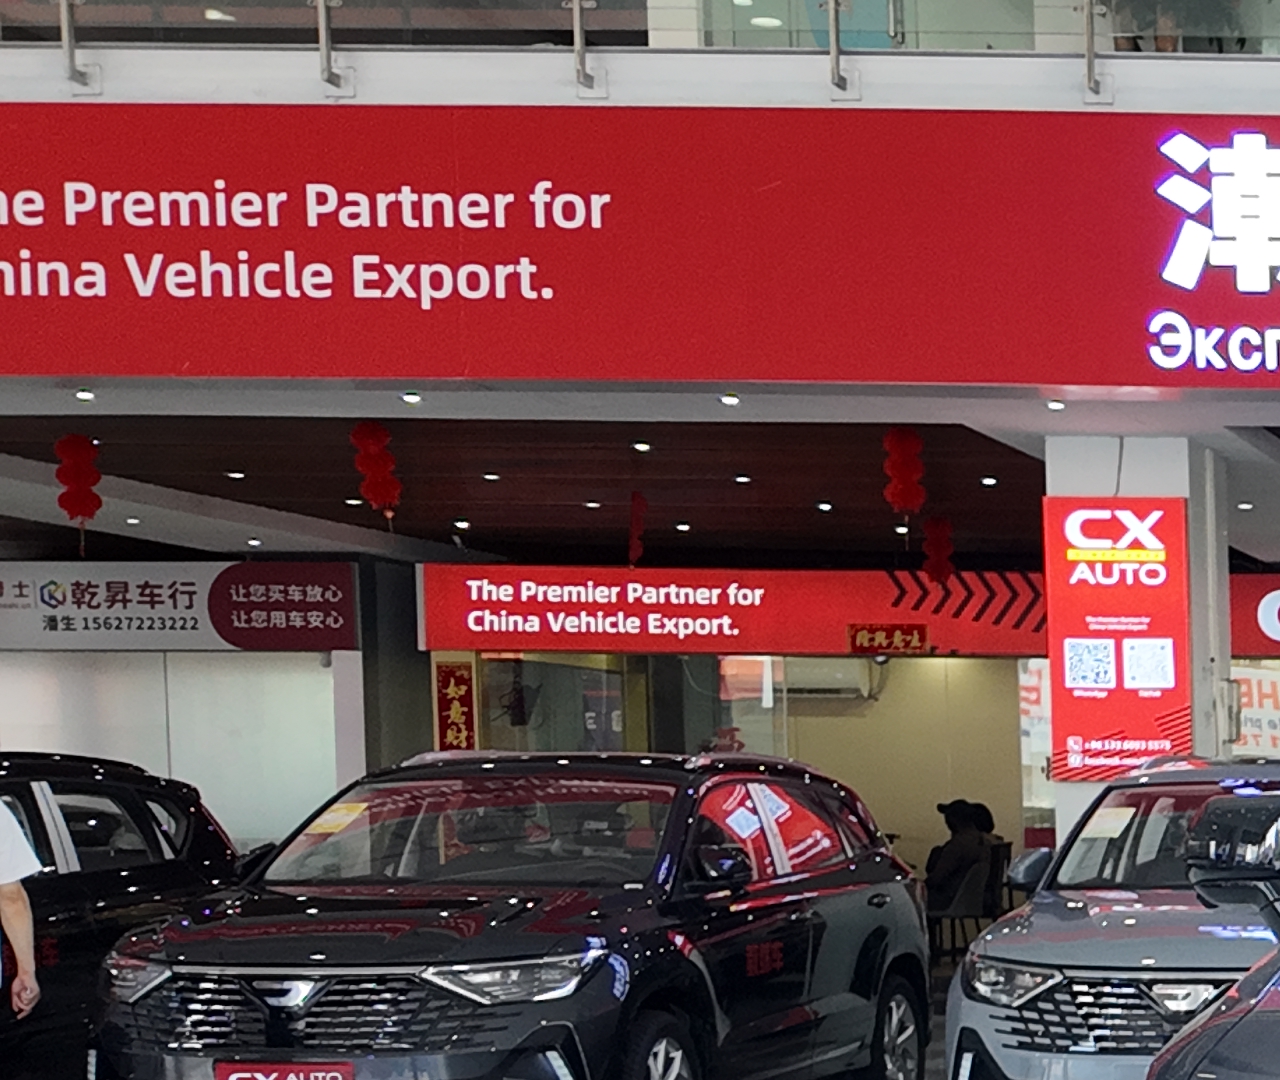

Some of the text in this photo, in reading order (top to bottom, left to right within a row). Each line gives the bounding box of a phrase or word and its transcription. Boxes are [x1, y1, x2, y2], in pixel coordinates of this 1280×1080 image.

[63, 179, 288, 228] Premier
[305, 183, 515, 229] Partner
[530, 181, 611, 229] for
[123, 250, 333, 299] Vehicle
[352, 254, 554, 310] Export.
[1064, 508, 1165, 550] CX
[1069, 562, 1167, 586] AUTO
[70, 579, 199, 610] 乾昇车行
[229, 584, 343, 602] 让您买车放心
[465, 578, 765, 606] The Premier Partner for
[82, 616, 199, 631] 15627223222
[231, 610, 344, 628] 让您用车安心
[467, 609, 740, 640] China Vehicle Export.
